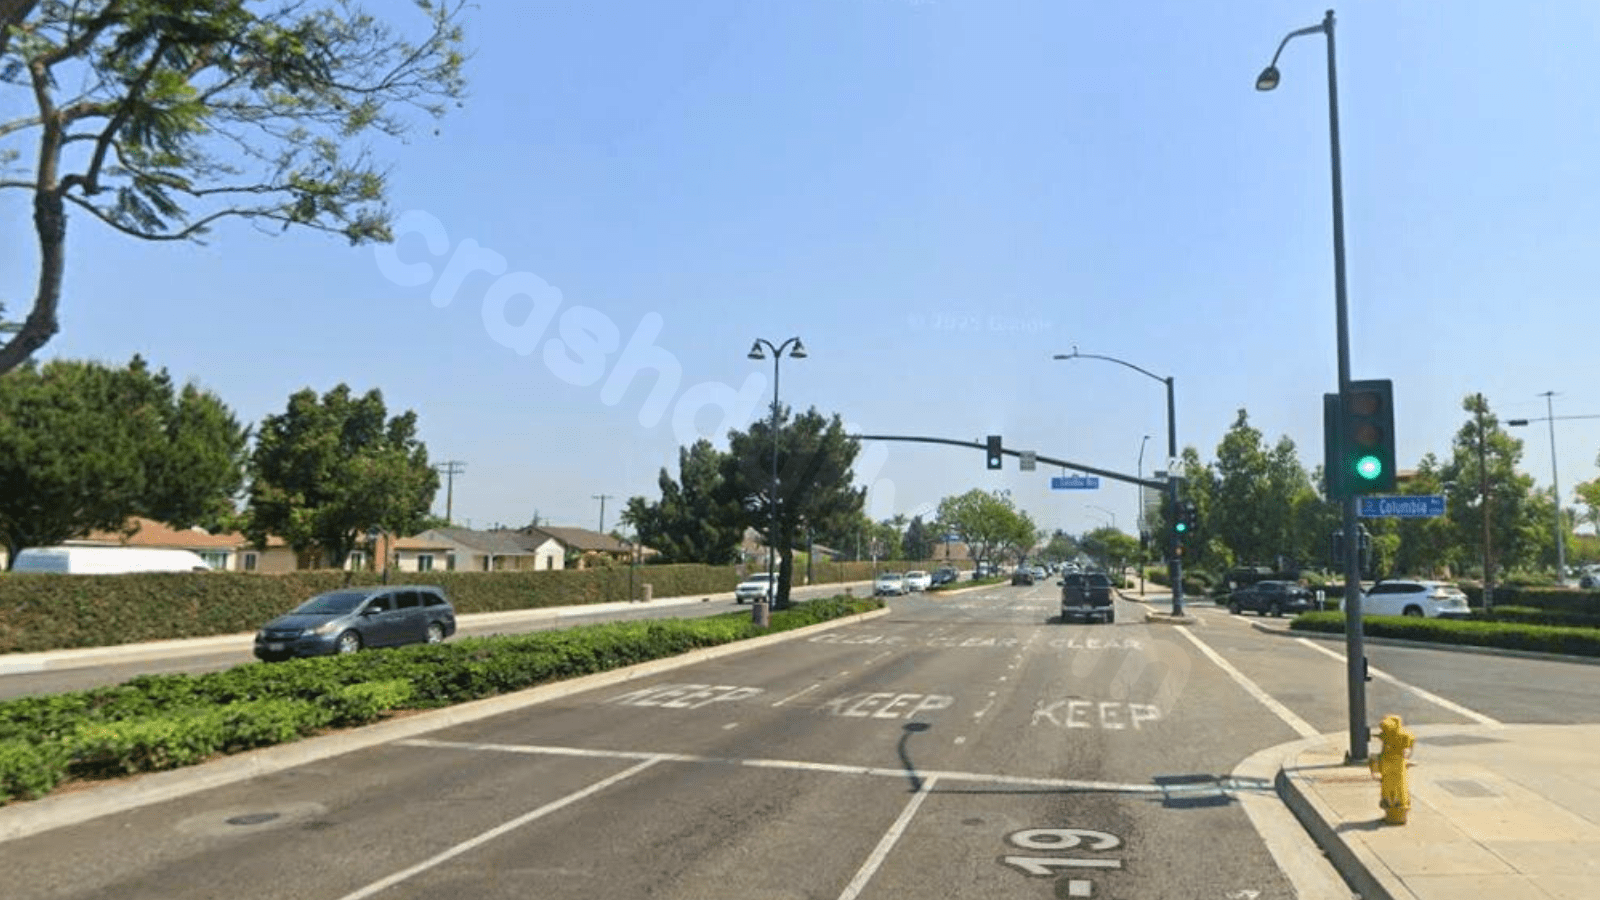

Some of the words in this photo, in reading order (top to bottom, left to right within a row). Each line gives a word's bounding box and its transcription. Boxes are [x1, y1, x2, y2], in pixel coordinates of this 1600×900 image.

[1378, 498, 1428, 514] Columbia
[1047, 638, 1143, 651] CLEAR
[603, 684, 764, 709] KEEP
[826, 692, 954, 719] KEEP
[1030, 700, 1161, 730] KEEP
